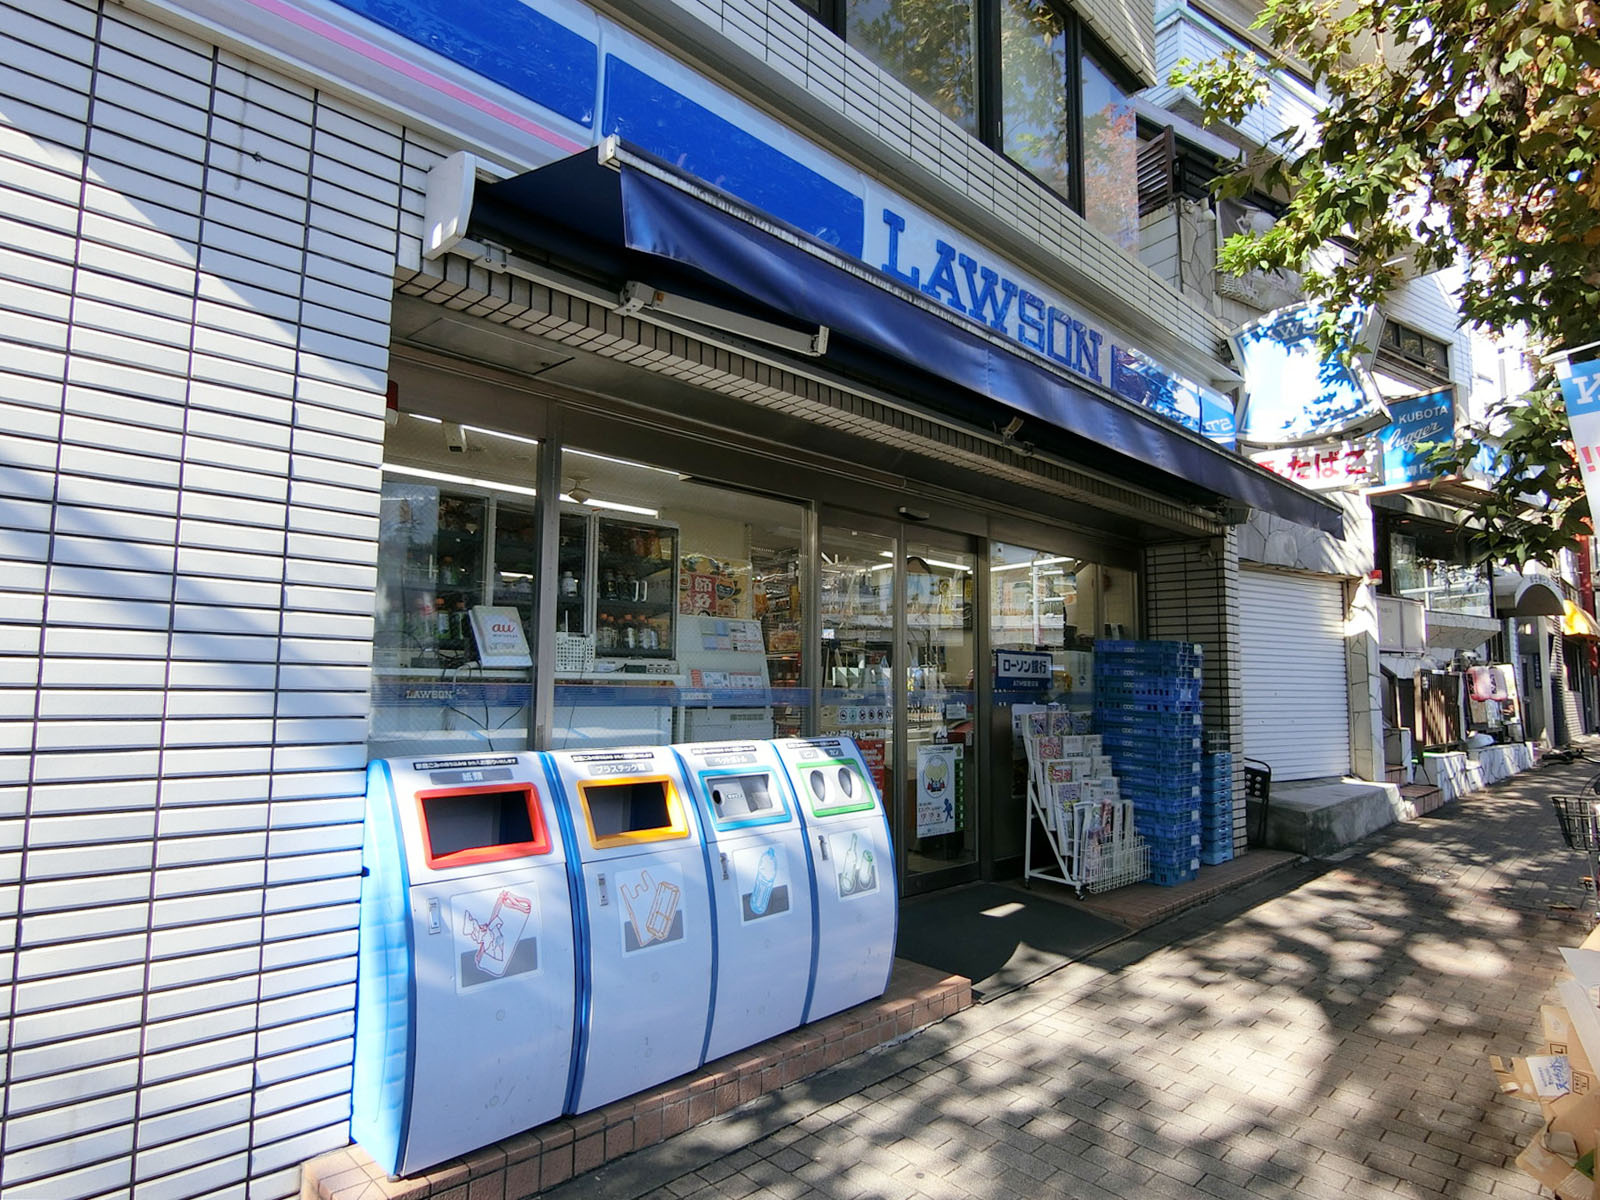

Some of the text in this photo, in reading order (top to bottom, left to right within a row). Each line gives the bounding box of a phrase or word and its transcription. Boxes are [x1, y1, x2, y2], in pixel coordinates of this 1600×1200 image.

[882, 209, 1103, 383] LAWSON
[1399, 405, 1449, 425] KUBOTA
[492, 623, 515, 633] au
[1003, 659, 1047, 674] ローソン銀行
[406, 690, 453, 699] LAWSON
